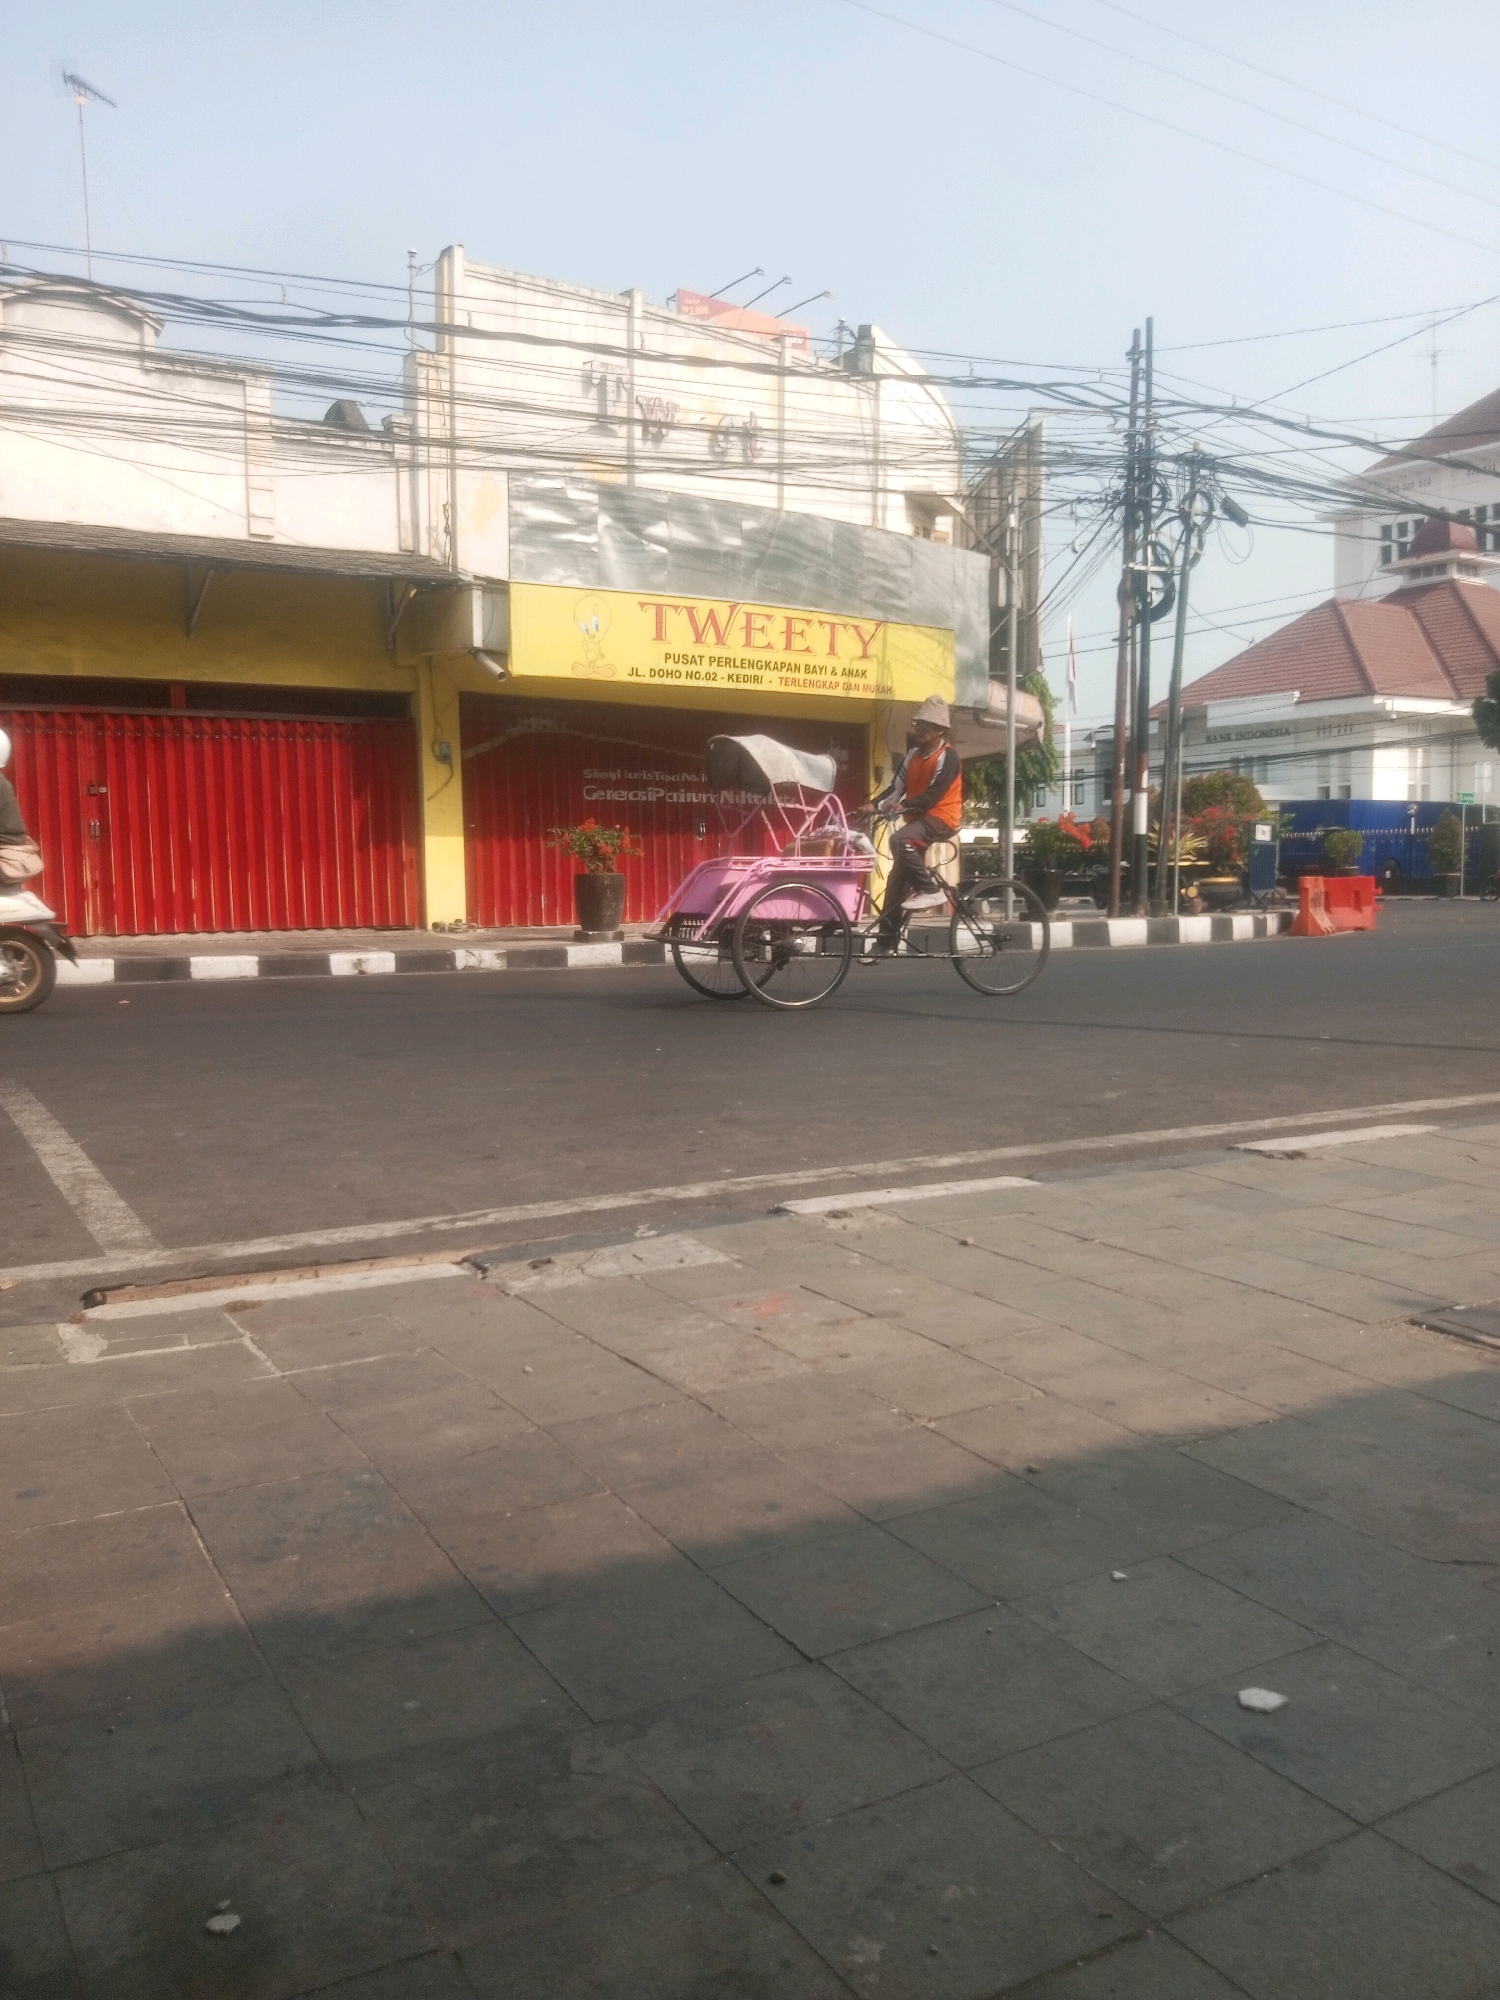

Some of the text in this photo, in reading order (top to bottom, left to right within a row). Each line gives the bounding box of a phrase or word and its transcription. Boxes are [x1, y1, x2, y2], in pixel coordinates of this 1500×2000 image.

[637, 601, 889, 662] TWEETY
[664, 652, 868, 679] PUSAT PERLENGKAPAN BAYI & ANAK
[627, 666, 646, 678] JL.
[649, 667, 682, 679] DOHO
[685, 669, 718, 682] NO.02
[727, 673, 764, 685] KEDIRI
[778, 676, 840, 691] TERLENGKAP
[842, 682, 860, 692] DAN
[862, 684, 893, 695] MURAH
[1206, 727, 1290, 745] BANK INDONESIA
